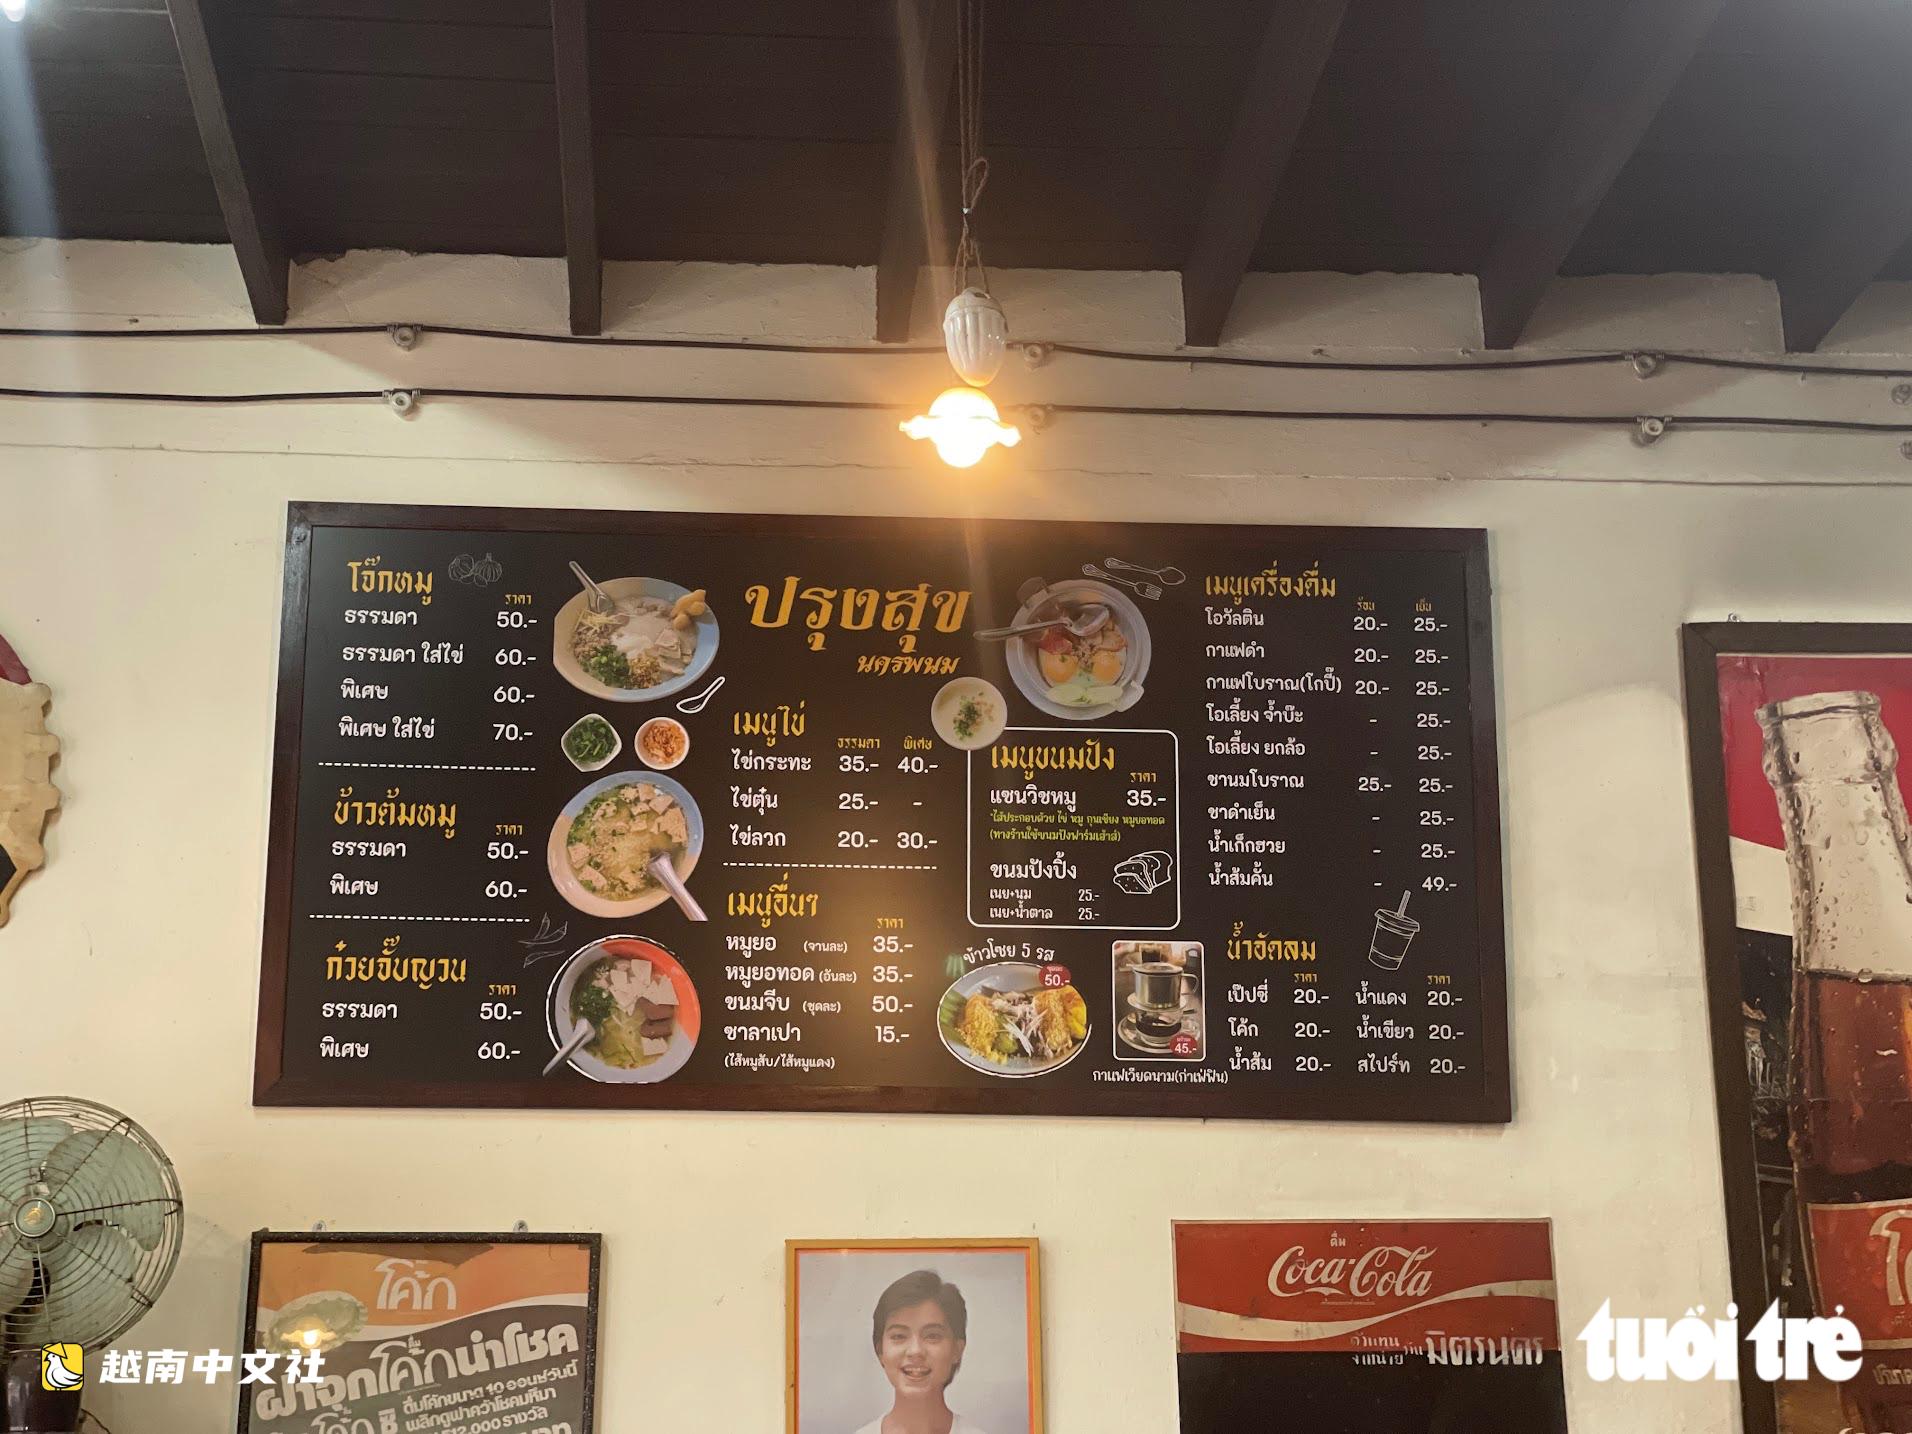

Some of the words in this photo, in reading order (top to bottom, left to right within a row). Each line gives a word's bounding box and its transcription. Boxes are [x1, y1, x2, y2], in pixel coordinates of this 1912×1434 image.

[348, 556, 432, 605] โจ๊กหมู
[1206, 560, 1335, 605] เมนูเครื่องดื่ม
[345, 610, 417, 625] ธรรมดา
[497, 611, 537, 628] 50.-
[745, 576, 971, 653] ปรุงสุข
[1205, 607, 1264, 625] โอวัลติน
[1354, 616, 1387, 630] 20.-
[1414, 617, 1447, 631] 25.-
[343, 647, 415, 662] ธรรมดา
[421, 641, 463, 664] ใส่ไข่
[495, 649, 536, 665] 60.-
[1206, 641, 1264, 658] กาแฟดำ
[1355, 648, 1388, 662] 20.-
[1415, 649, 1448, 663] 25.-
[858, 656, 960, 676] นครพนม
[341, 678, 388, 699] พิเศษ
[494, 686, 535, 703] 60.-
[1355, 681, 1389, 694] 20.-
[1416, 681, 1450, 695] 25.-
[734, 700, 804, 747] เมนูไข่
[1206, 697, 1259, 722] โอเลี้ยง
[1264, 700, 1303, 723] จ้ำบ๊ะ
[1417, 713, 1450, 727] 25.-
[339, 716, 386, 737] พิเศษ
[392, 716, 434, 738] ใส่ไข่
[493, 724, 533, 741] 70.-
[1206, 730, 1259, 754] โอเลี้ยง
[1264, 737, 1305, 755] ยกล้อ
[1418, 746, 1452, 760] 25.-
[731, 748, 811, 770] ไข่กระทะ
[839, 755, 879, 772] 35.-
[898, 757, 938, 773] 40.-
[991, 738, 1116, 780] เมนูขนมปัง
[1130, 773, 1156, 782] ราคา
[1207, 768, 1304, 788] ชานมโบราณ
[1359, 777, 1391, 791] 25.-
[1419, 778, 1453, 792] 25.-
[730, 786, 778, 815] ไข่ตุ๋น
[839, 793, 878, 809] 25.-
[1127, 790, 1166, 806] 35.-
[334, 786, 456, 839] ข้าวต้มหมู
[1208, 801, 1275, 820] ชาดำเย็น
[1420, 811, 1454, 825] 25.-
[730, 824, 786, 846] ไข่ลวก
[838, 831, 878, 848] 20.-
[897, 832, 937, 849] 30.-
[332, 841, 406, 857] ธรรมดา
[487, 842, 528, 859] 50.-
[1421, 844, 1455, 858] 25.-
[990, 851, 1076, 879] ขนมปังปิ้ง
[1209, 861, 1273, 886] น้ำส้มคั้น
[1422, 877, 1457, 891] 49.-
[330, 873, 378, 895] พิเศษ
[485, 881, 527, 898] 60.-
[1079, 889, 1099, 901] 25.-
[728, 872, 818, 928] เมนูอื่นๆ
[1078, 908, 1099, 920] 25.-
[726, 936, 776, 958] หมูยอ
[804, 941, 847, 953] (จานละ)
[873, 936, 913, 952] 35.-
[1022, 943, 1030, 957] 5
[1036, 948, 1054, 961] รส
[1227, 921, 1315, 961] น้ำอัดลม
[326, 935, 466, 989] ก๋วยจั๊บญวน
[725, 966, 814, 988] หมูยอทอด
[819, 969, 856, 983] (อันละ)
[873, 966, 913, 982] 35.-
[1044, 974, 1070, 987] 50.-
[725, 989, 789, 1011] ขนมจีบ
[872, 996, 913, 1012] 50.-
[1228, 979, 1268, 1003] เป๊ปซี่
[1294, 989, 1329, 1004] 20.-
[1356, 981, 1406, 1005] น้ำแดง
[1428, 991, 1462, 1006] 20.-
[322, 1003, 397, 1018] ธรรมดา
[480, 1003, 522, 1020] 50.-
[724, 1023, 800, 1041] ซาลาเปา
[875, 1026, 909, 1042] 15.-
[1228, 1017, 1258, 1036] โค้ก
[1295, 1022, 1330, 1037] 20.-
[1357, 1014, 1414, 1039] น้ำเขียว
[1429, 1025, 1464, 1039] 20.-
[320, 1036, 369, 1057] พิเศษ
[478, 1042, 520, 1059] 60.-
[1174, 1042, 1197, 1054] 45.-
[1229, 1046, 1271, 1070] น้ำส้ม
[1296, 1056, 1331, 1071] 20.-
[1358, 1052, 1410, 1072] สไปร์ท
[1430, 1059, 1465, 1073] 20.-
[1267, 1245, 1438, 1298] Coca-Cola
[376, 1259, 457, 1312] โค้ก
